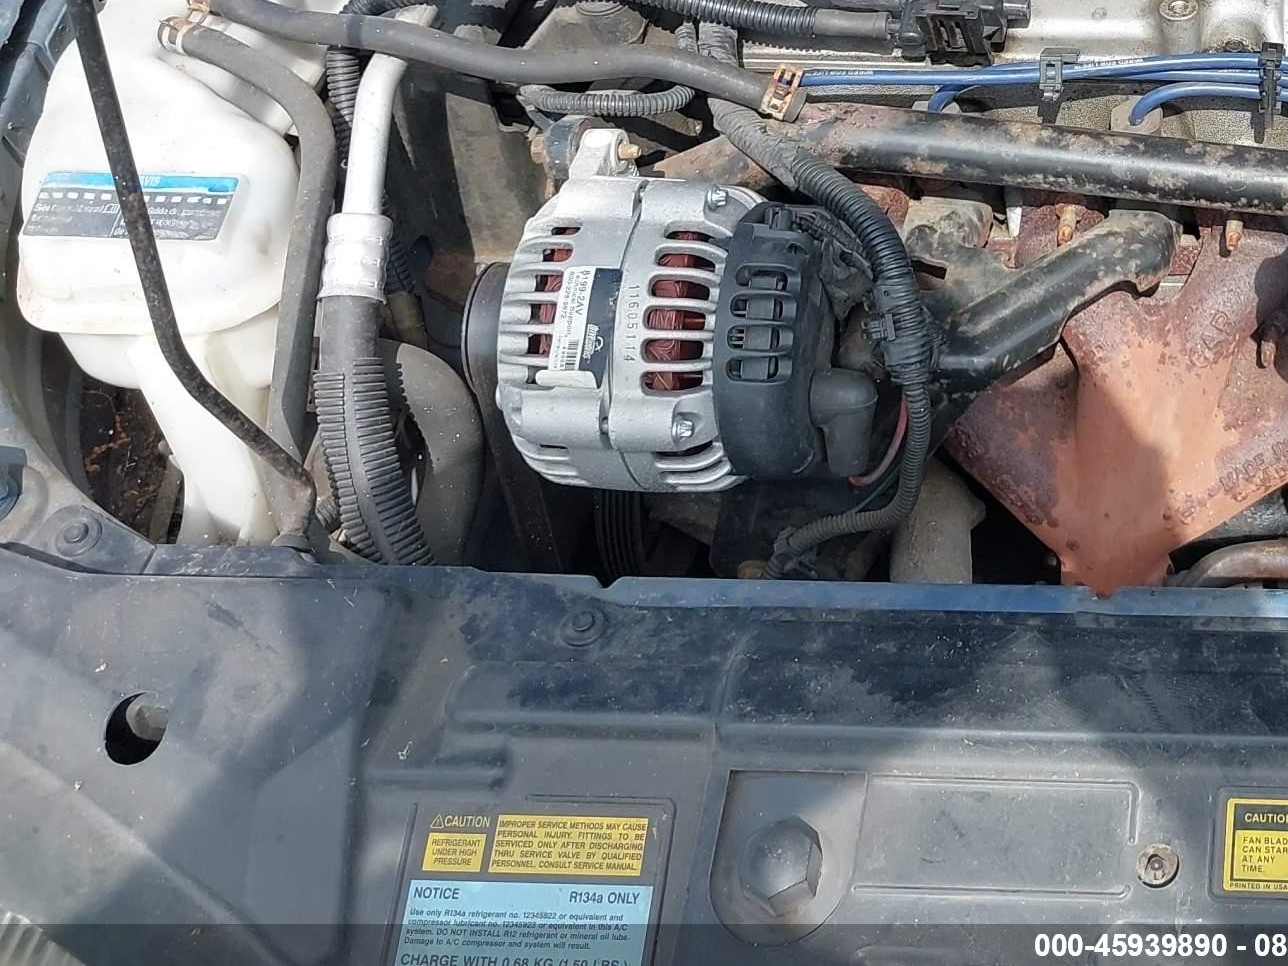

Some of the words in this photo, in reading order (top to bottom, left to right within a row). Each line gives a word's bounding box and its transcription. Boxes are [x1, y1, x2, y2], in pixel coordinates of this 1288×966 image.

[623, 284, 641, 362] 11605114
[444, 814, 491, 828] CAUTION
[499, 819, 537, 830] IMPROPER
[537, 820, 568, 830] SERVICE
[569, 821, 604, 831] METHODS
[606, 822, 621, 831] MAY
[622, 822, 647, 832] CAUSE
[497, 829, 538, 839] PERSONAL
[577, 831, 613, 841] FITTINGS
[618, 832, 629, 841] TO
[633, 833, 645, 842] BE
[1242, 836, 1262, 845] FAN
[431, 838, 481, 848] REFRIGERANT
[495, 839, 535, 849] SERVICED
[537, 840, 558, 850] ONLY
[560, 841, 586, 850] AFTER
[589, 841, 643, 852] DISCHARGING
[432, 848, 458, 857] UNDER
[458, 849, 477, 857] HIGH
[493, 849, 515, 859] THRU
[519, 850, 553, 860] SERVICE
[557, 851, 582, 860] VALVE
[585, 851, 598, 860] BY
[600, 852, 643, 862] QUALIFIED
[1242, 845, 1263, 855] CAN
[433, 857, 472, 866] PRESSURE
[538, 860, 572, 870] CONSULT
[573, 861, 605, 870] SERVICE
[605, 862, 638, 871] MANUAL.
[1242, 855, 1255, 864] AT
[1256, 855, 1276, 865] ANY
[1241, 864, 1264, 874] TIME.
[1229, 882, 1262, 890] PRINTED
[1262, 883, 1271, 891] IN
[1272, 883, 1288, 891] USA
[413, 887, 461, 901] NOTICE
[568, 891, 604, 904] R134a
[607, 892, 642, 905] ONLY
[410, 907, 424, 917] Use
[426, 909, 442, 919] only
[444, 909, 466, 918] R134a
[468, 910, 508, 921] refrigerant
[568, 913, 607, 923] equivalent
[609, 913, 624, 922] and
[405, 927, 435, 938] system.
[450, 928, 467, 937] NOT
[469, 928, 501, 938] INSTALL
[518, 930, 558, 941] refrigerant
[569, 932, 598, 941] mineral
[403, 936, 435, 947] Damage
[445, 937, 460, 947] A/C
[461, 939, 506, 949] compressor
[508, 940, 522, 948] and
[524, 941, 551, 950] system
[567, 942, 592, 950] result.
[400, 953, 459, 966] CHARGE
[462, 955, 498, 966] WITH
[533, 957, 555, 966] KG
